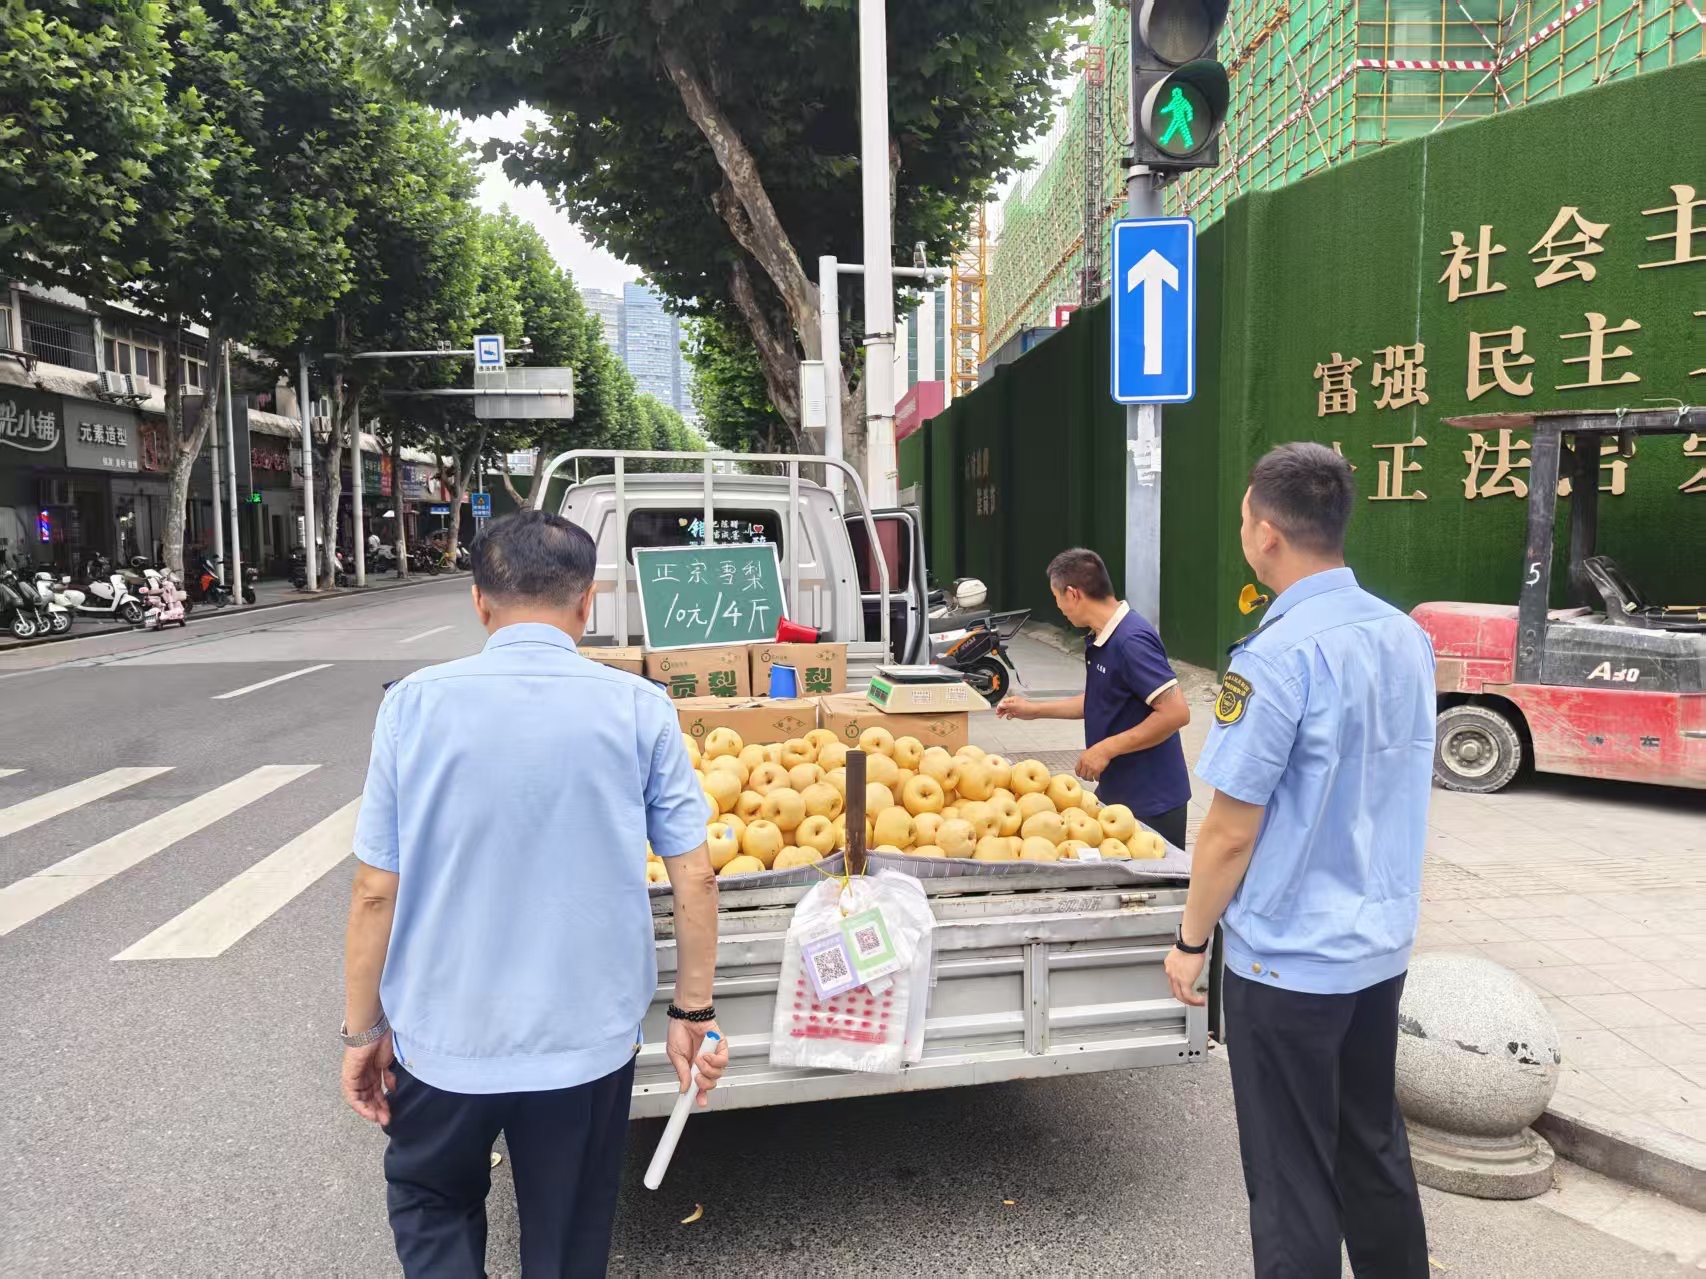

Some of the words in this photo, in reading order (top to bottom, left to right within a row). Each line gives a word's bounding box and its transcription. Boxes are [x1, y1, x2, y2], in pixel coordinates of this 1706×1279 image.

[1313, 342, 1429, 417] 富强
[1466, 312, 1641, 401] 民主
[80, 422, 128, 446] 元素造型
[652, 560, 764, 591] 正宗雪梨
[1525, 562, 1541, 587] 5
[669, 670, 738, 697] 贡梨
[1587, 661, 1640, 682] A30
